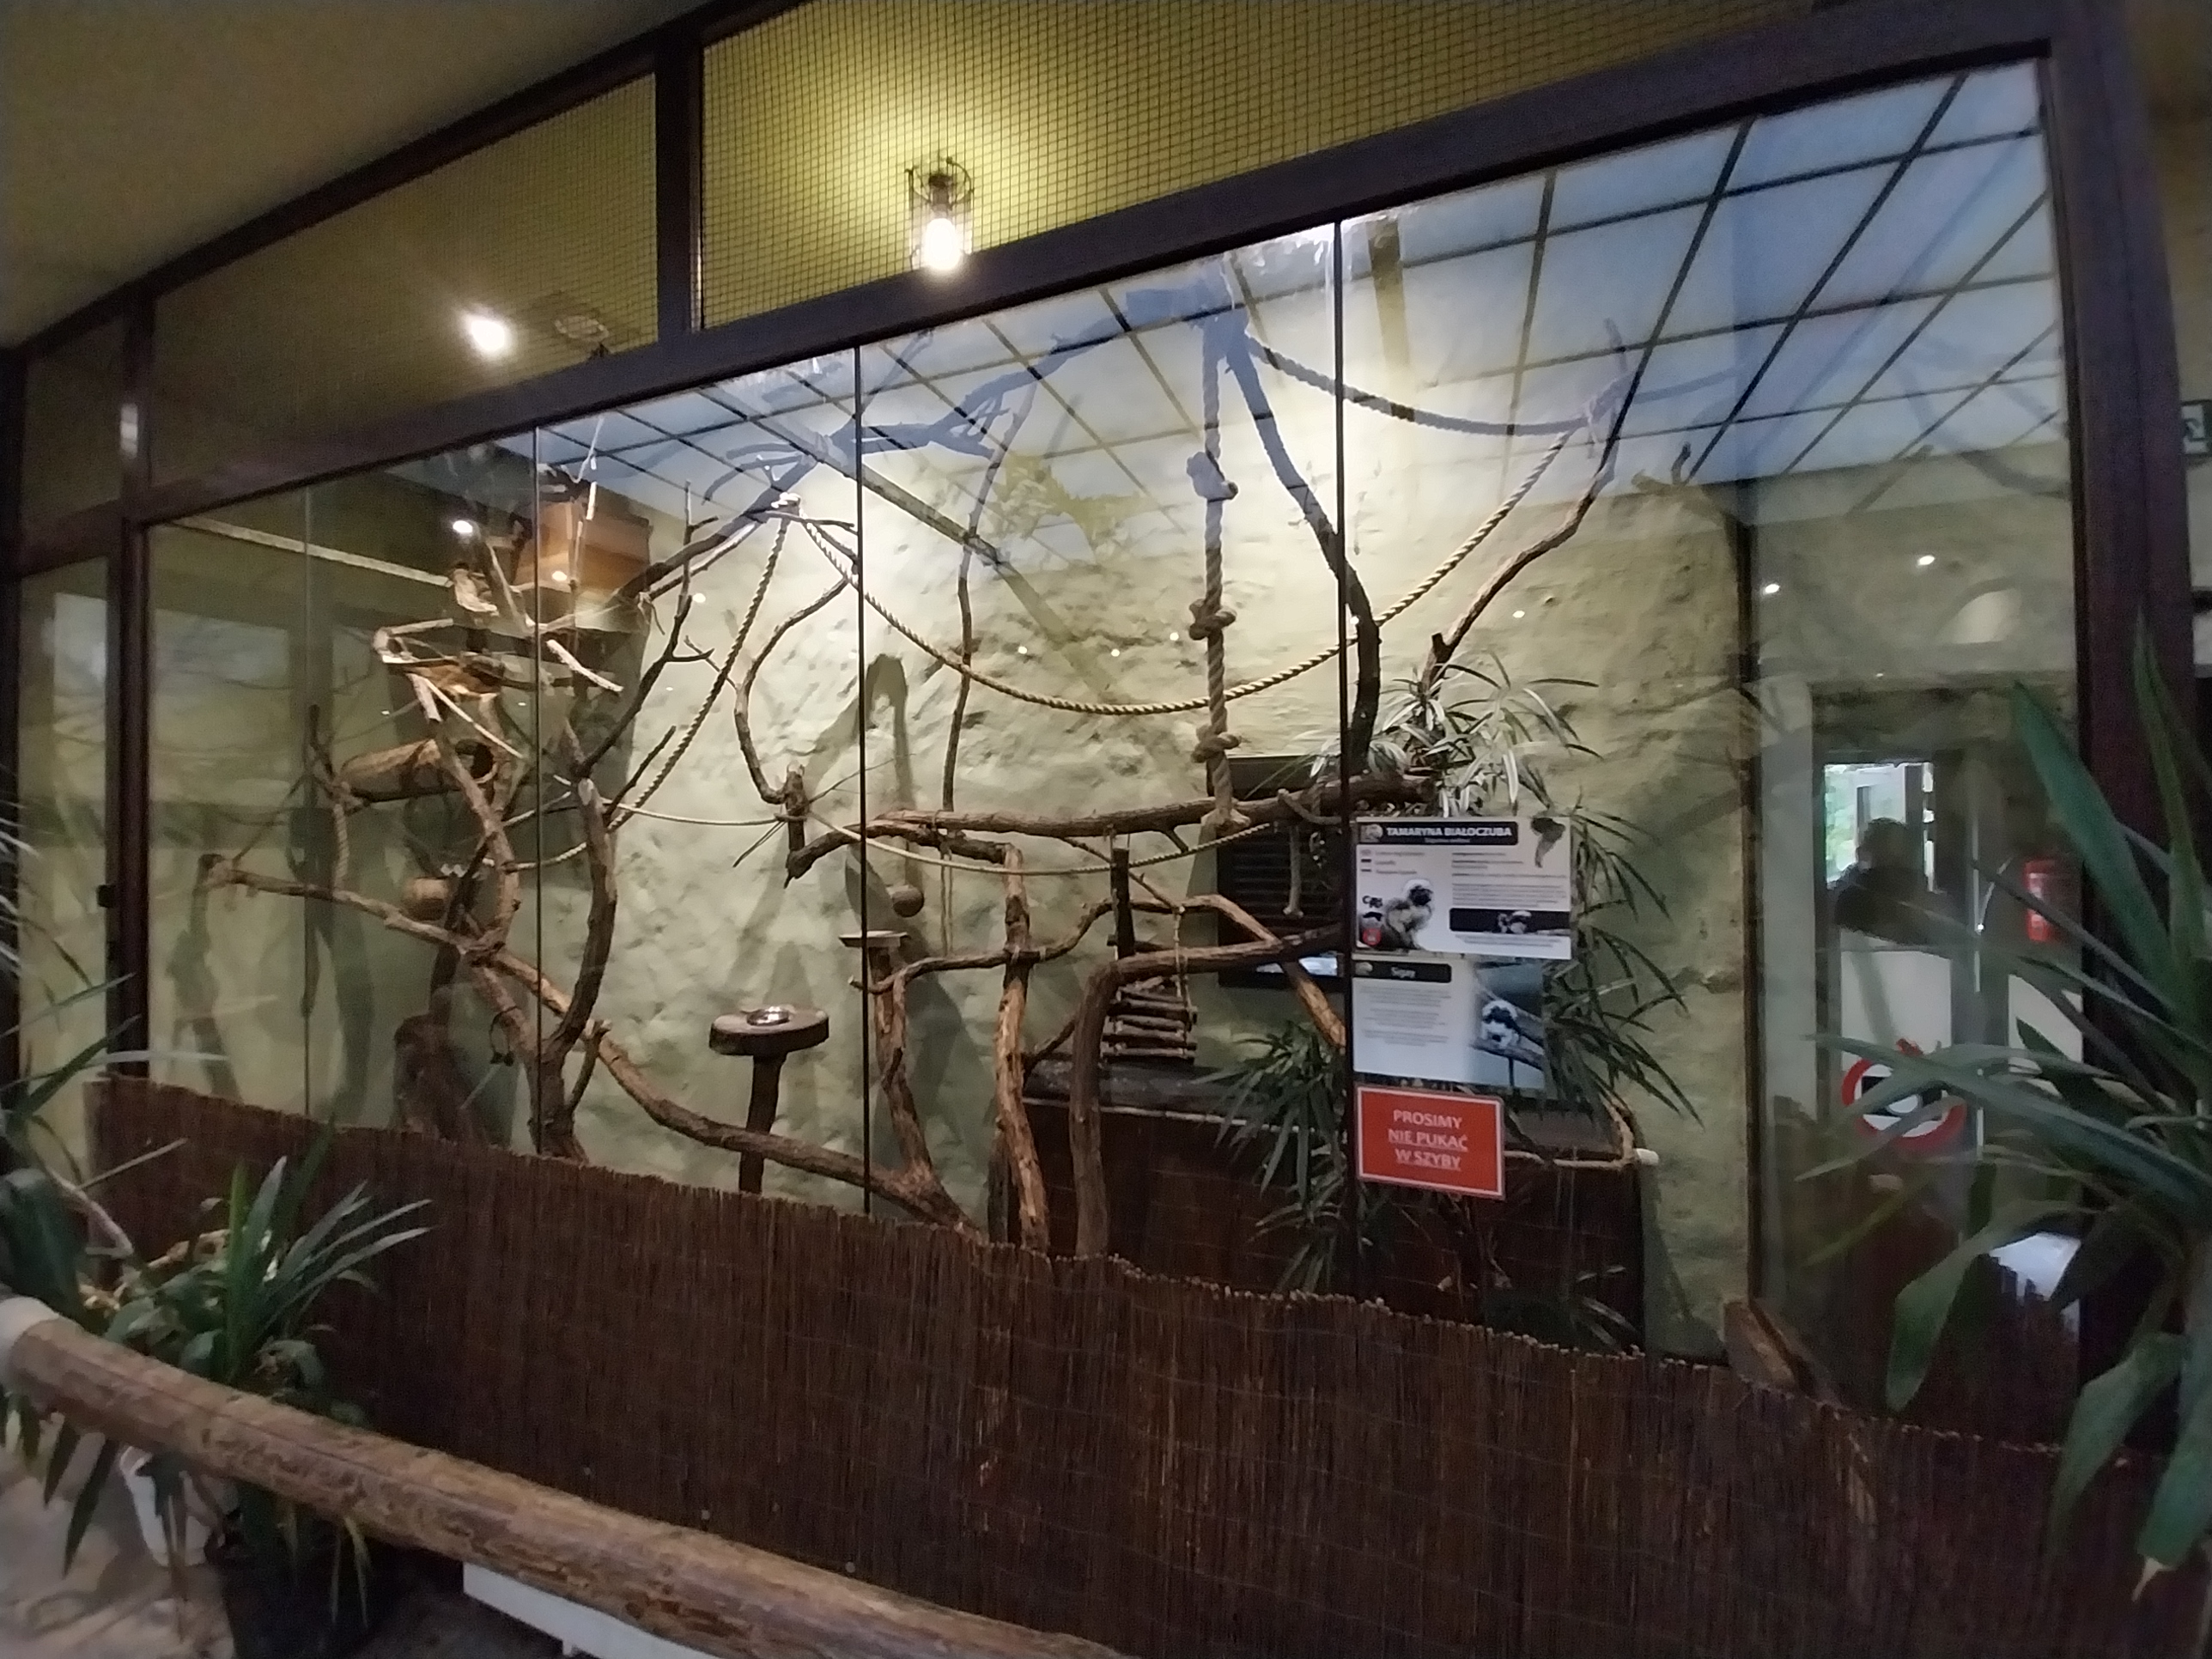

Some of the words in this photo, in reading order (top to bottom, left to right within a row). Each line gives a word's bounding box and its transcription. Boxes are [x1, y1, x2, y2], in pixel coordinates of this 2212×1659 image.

[1393, 1109, 1462, 1129] PROSIMY
[1388, 1127, 1413, 1144] NIE
[1416, 1131, 1468, 1152] PUKAĆ
[1395, 1148, 1413, 1164] W
[1413, 1151, 1462, 1170] SZYBY
